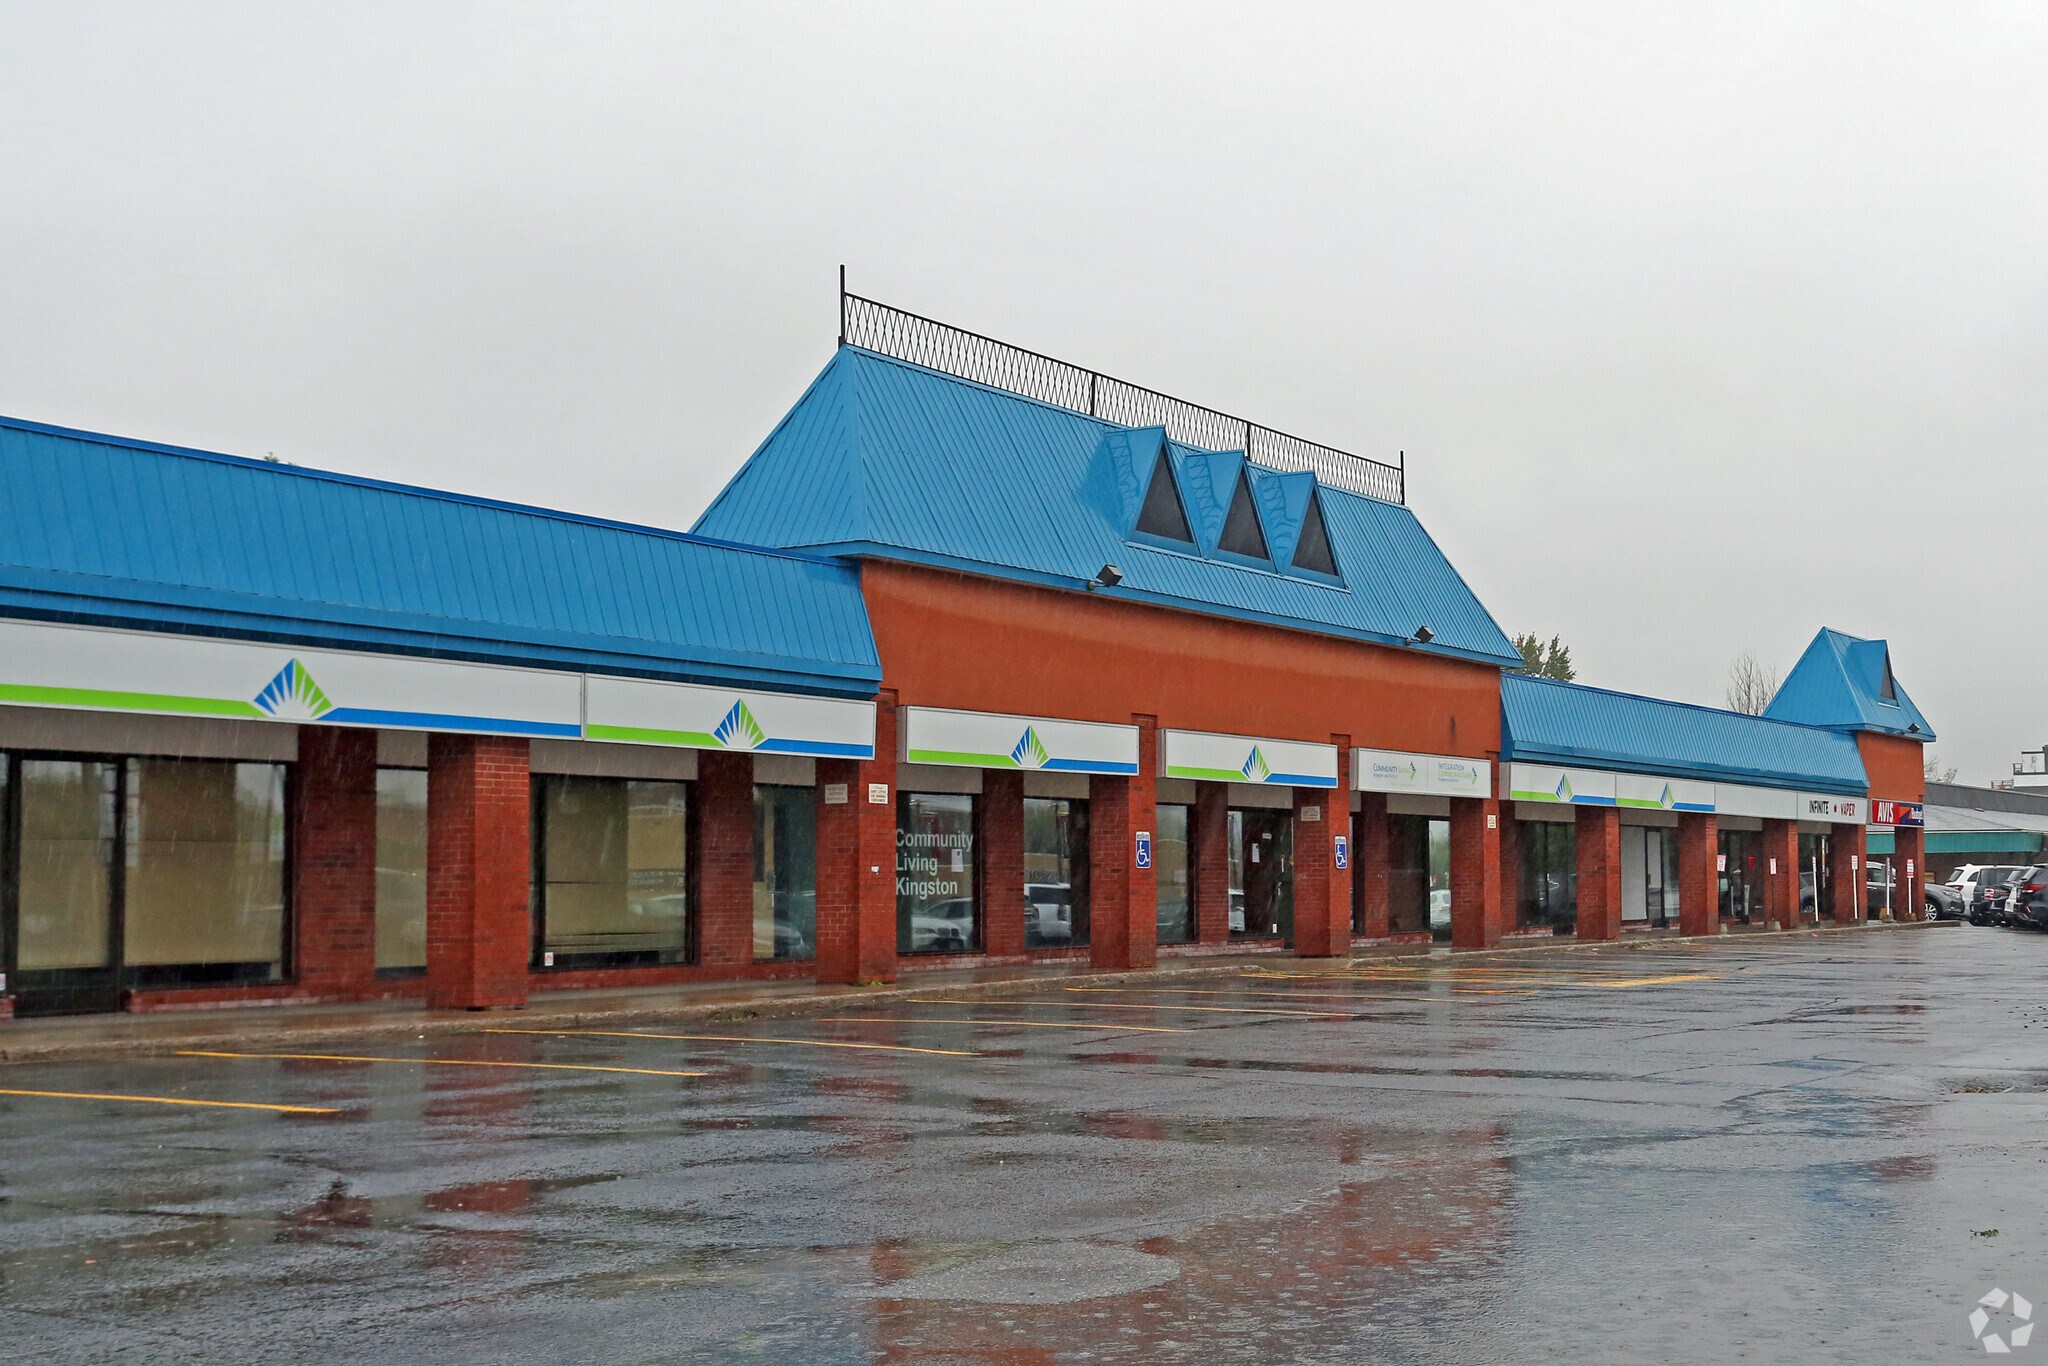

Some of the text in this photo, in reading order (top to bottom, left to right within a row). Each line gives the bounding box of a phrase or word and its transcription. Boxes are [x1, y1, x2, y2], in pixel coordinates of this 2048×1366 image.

[1809, 800, 1856, 817] INFINITE VAPER
[1877, 801, 1894, 823] AVIS
[896, 828, 973, 853] Community
[896, 852, 938, 876] Living
[896, 877, 958, 900] Kingston
